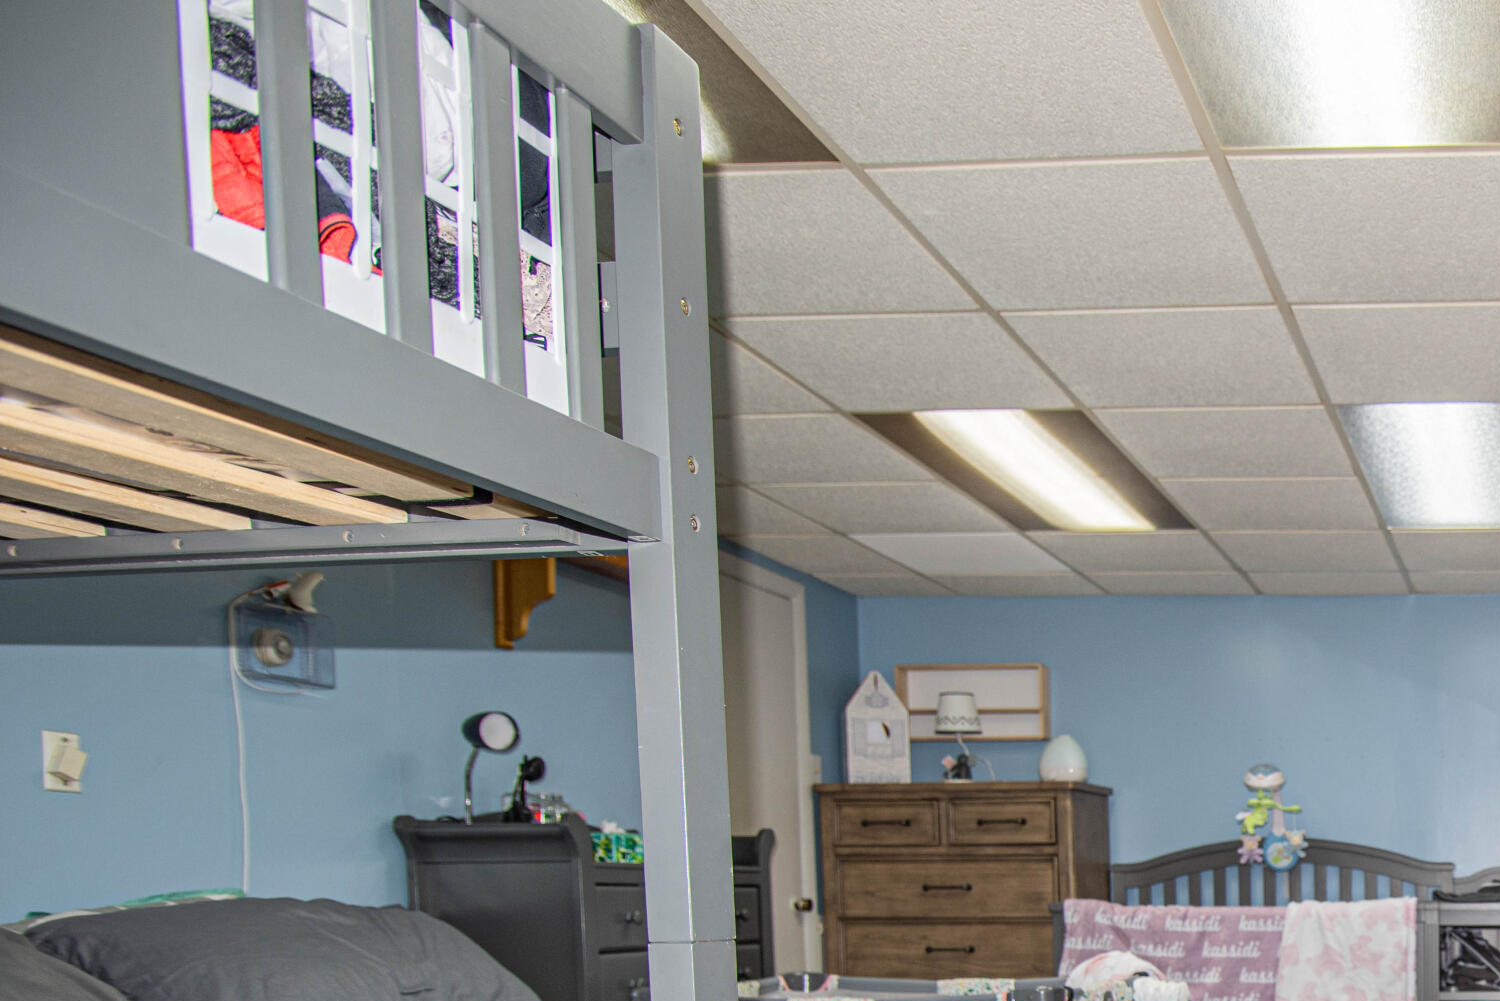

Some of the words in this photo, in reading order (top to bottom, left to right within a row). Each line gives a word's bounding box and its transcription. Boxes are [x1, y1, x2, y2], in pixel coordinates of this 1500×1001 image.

[1164, 913, 1221, 932] kassidi
[1064, 934, 1114, 951] assidi
[1129, 939, 1186, 958] kassidi
[1201, 940, 1262, 958] kassidi
[1165, 966, 1222, 984] kassidi
[1238, 966, 1276, 984] kass
